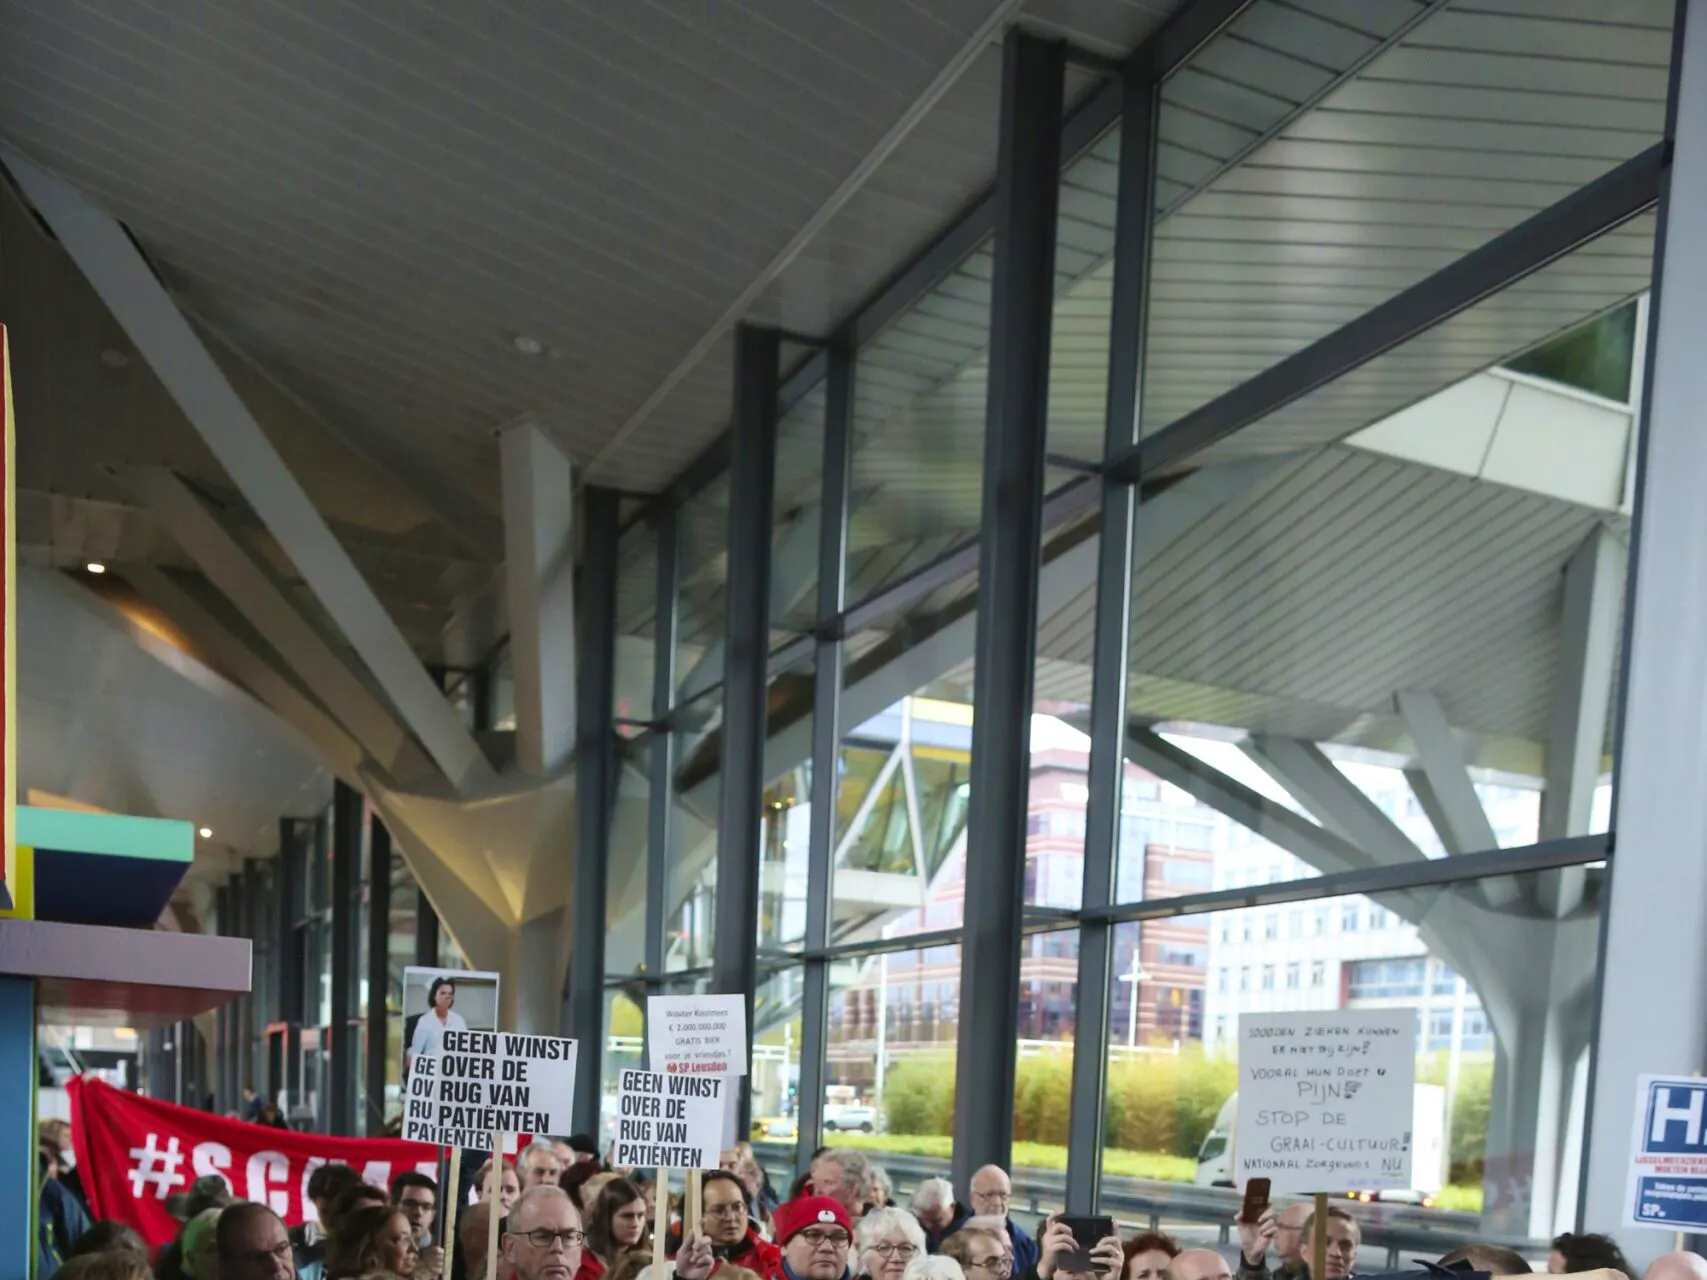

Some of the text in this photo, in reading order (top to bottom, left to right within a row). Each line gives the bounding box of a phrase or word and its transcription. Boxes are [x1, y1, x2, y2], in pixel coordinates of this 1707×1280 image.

[665, 1009, 693, 1018] Wouter
[674, 1036, 721, 1046] GRATIS BIER
[1303, 1026, 1350, 1037] ZIEKEN
[1356, 1026, 1401, 1037] KUNNEN
[442, 1030, 573, 1061] GEEN WINST
[683, 1052, 691, 1060] je
[441, 1055, 528, 1082] OVER DE
[678, 1061, 727, 1073] SP Leusden
[1250, 1068, 1299, 1081] VOORAL
[1306, 1067, 1332, 1077] HUN
[439, 1080, 530, 1108] RUG VAN
[622, 1071, 722, 1099] GEEN WINST
[621, 1094, 687, 1120] OVER DE
[438, 1105, 550, 1134] PATIËNTEN
[1254, 1109, 1348, 1127] STOP DE
[620, 1119, 688, 1143] RUG VAN
[618, 1142, 703, 1168] PATIËNTEN
[1243, 1157, 1302, 1171] NATIONAAL
[1380, 1157, 1403, 1172] NU
